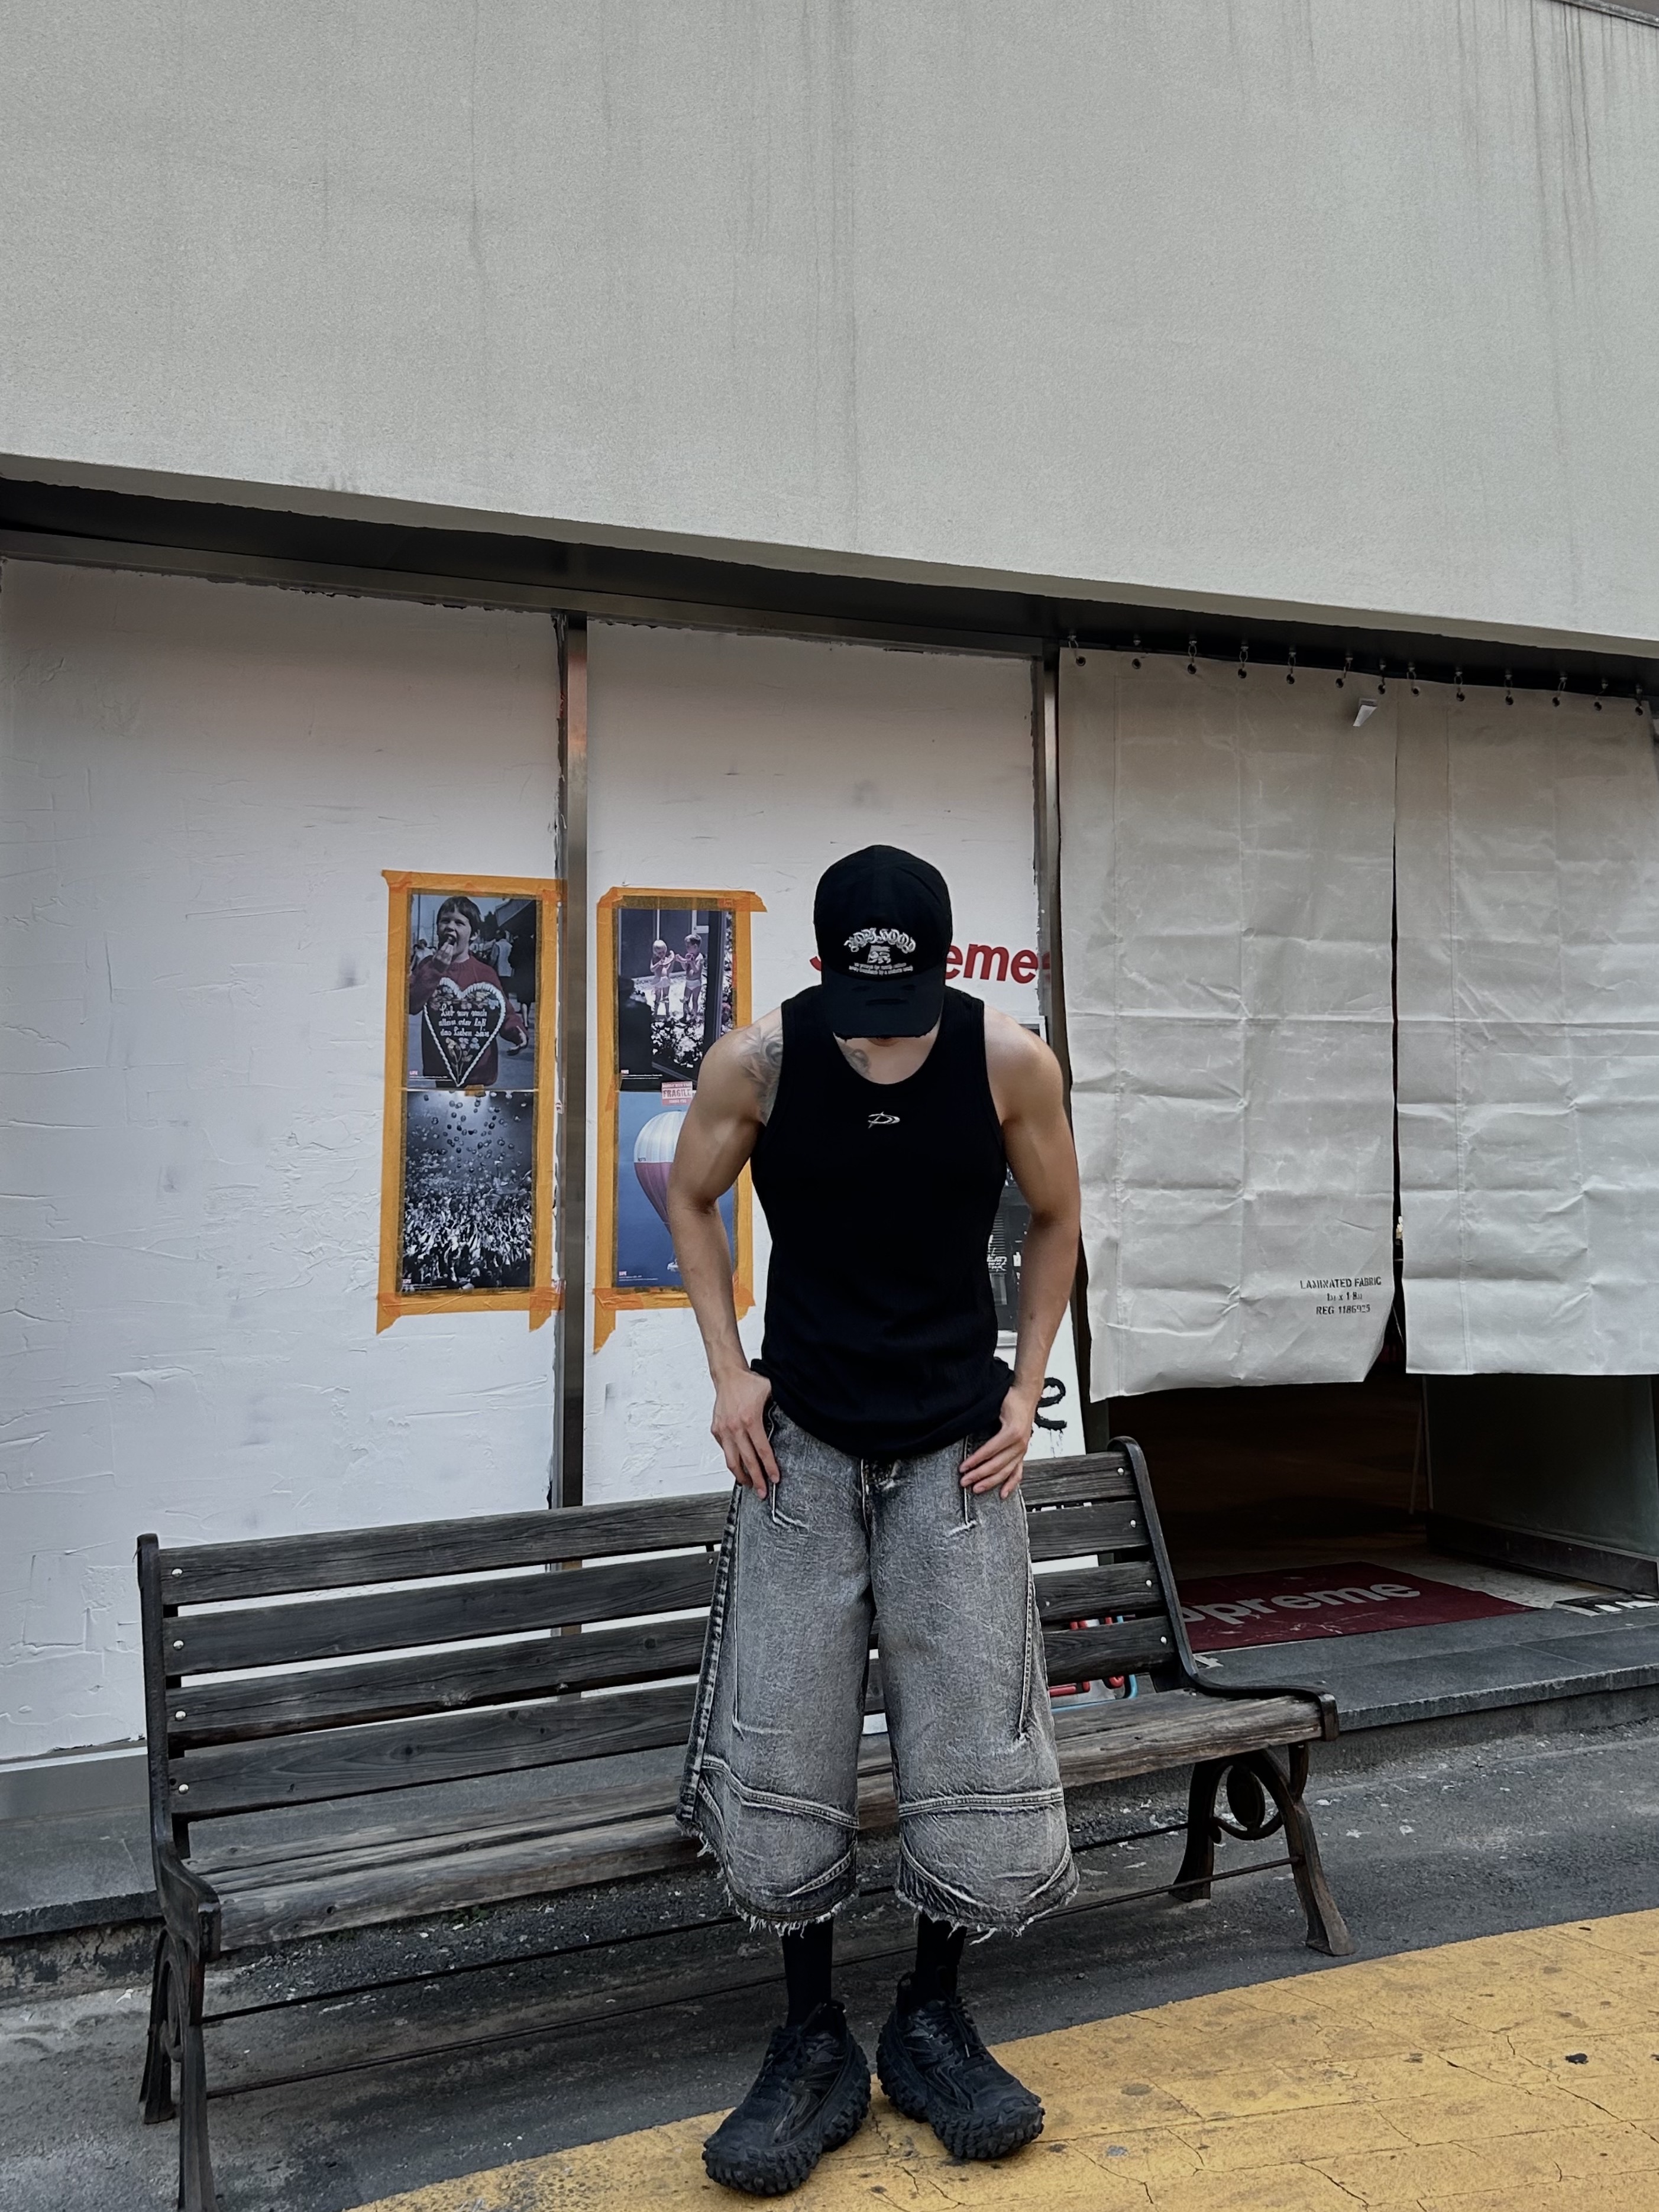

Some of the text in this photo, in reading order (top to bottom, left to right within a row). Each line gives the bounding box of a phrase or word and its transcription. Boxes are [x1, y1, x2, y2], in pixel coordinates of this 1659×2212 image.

[663, 1089, 691, 1097] FRAGILE
[1300, 1277, 1382, 1289] LAMINATED FABRIC
[1316, 1306, 1334, 1314] REG
[1183, 1583, 1420, 1625] preme
